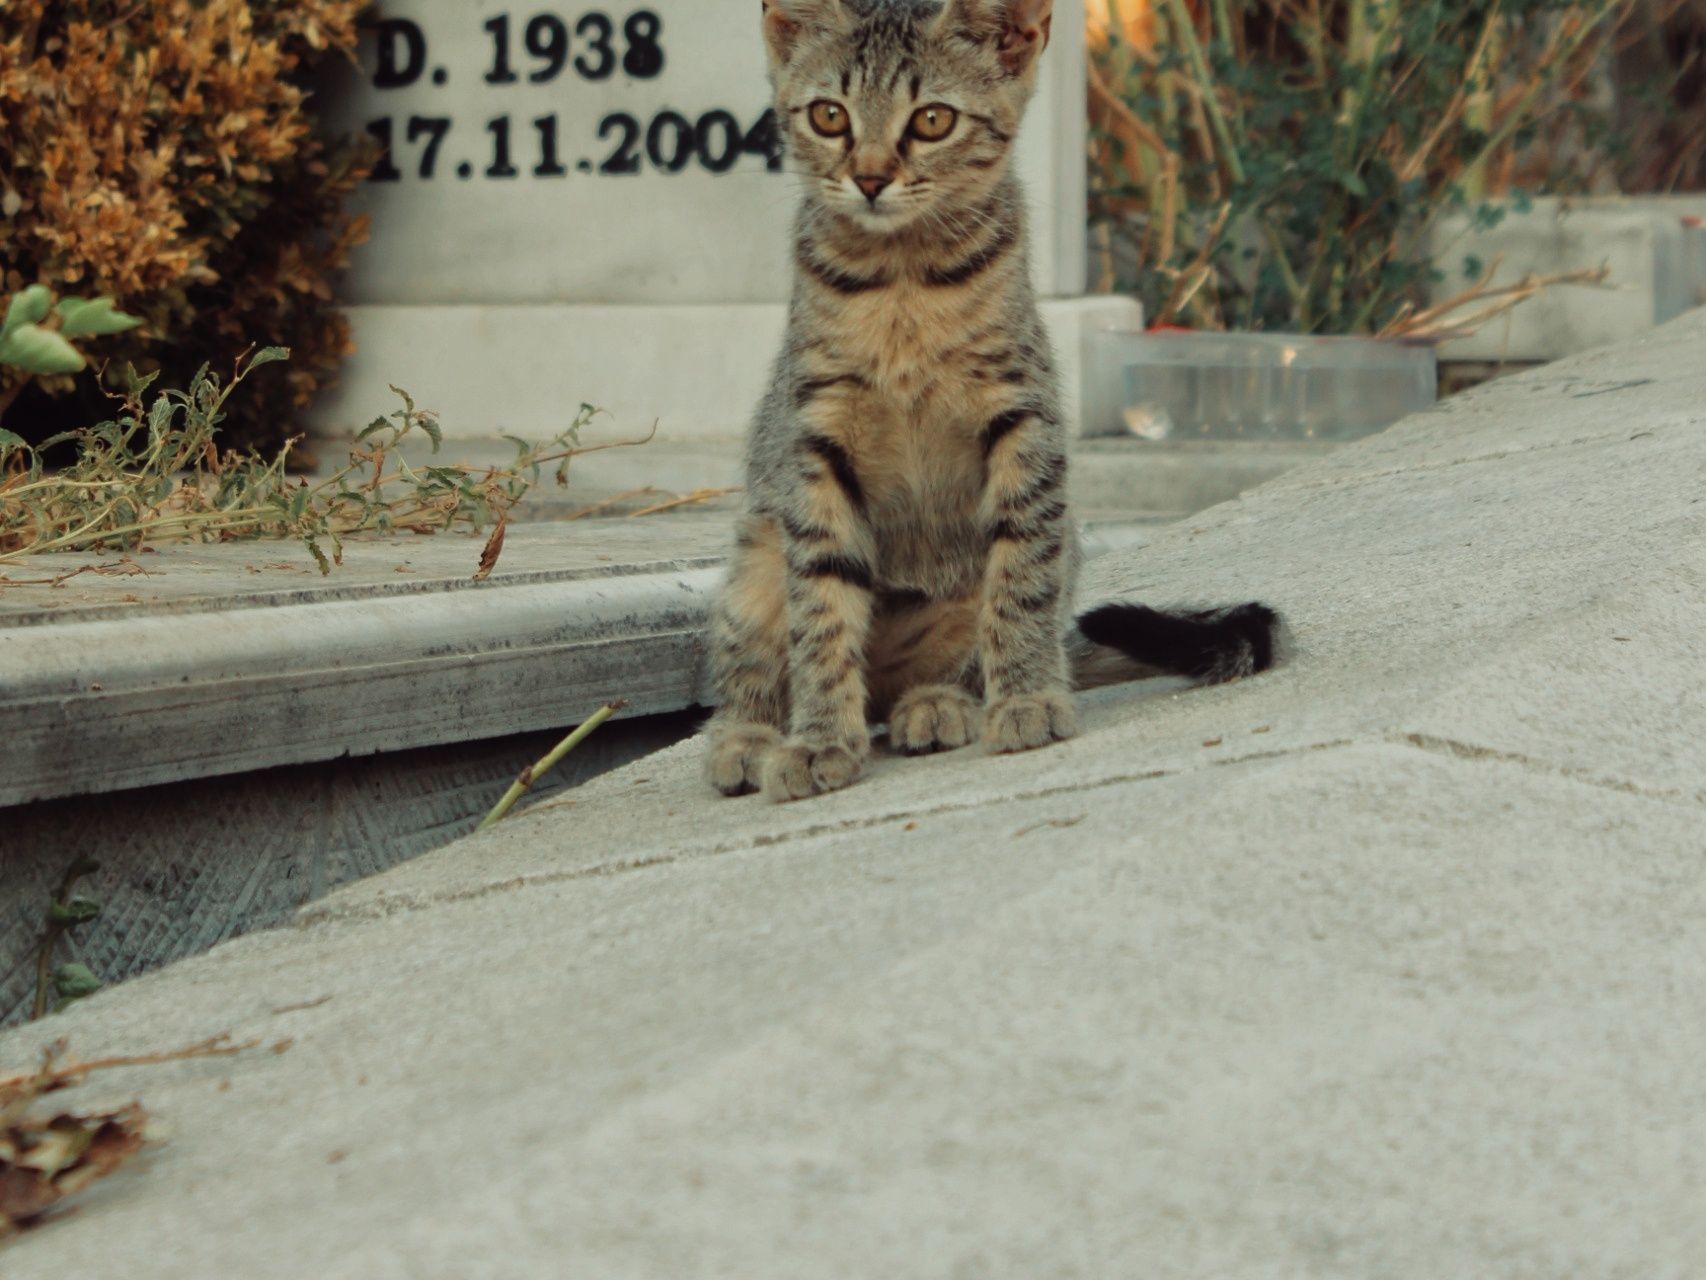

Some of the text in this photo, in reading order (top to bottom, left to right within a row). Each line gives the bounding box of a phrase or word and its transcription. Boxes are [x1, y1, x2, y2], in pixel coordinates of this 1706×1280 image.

[370, 11, 665, 89] D. 1938
[366, 108, 783, 181] 17.11.2004
